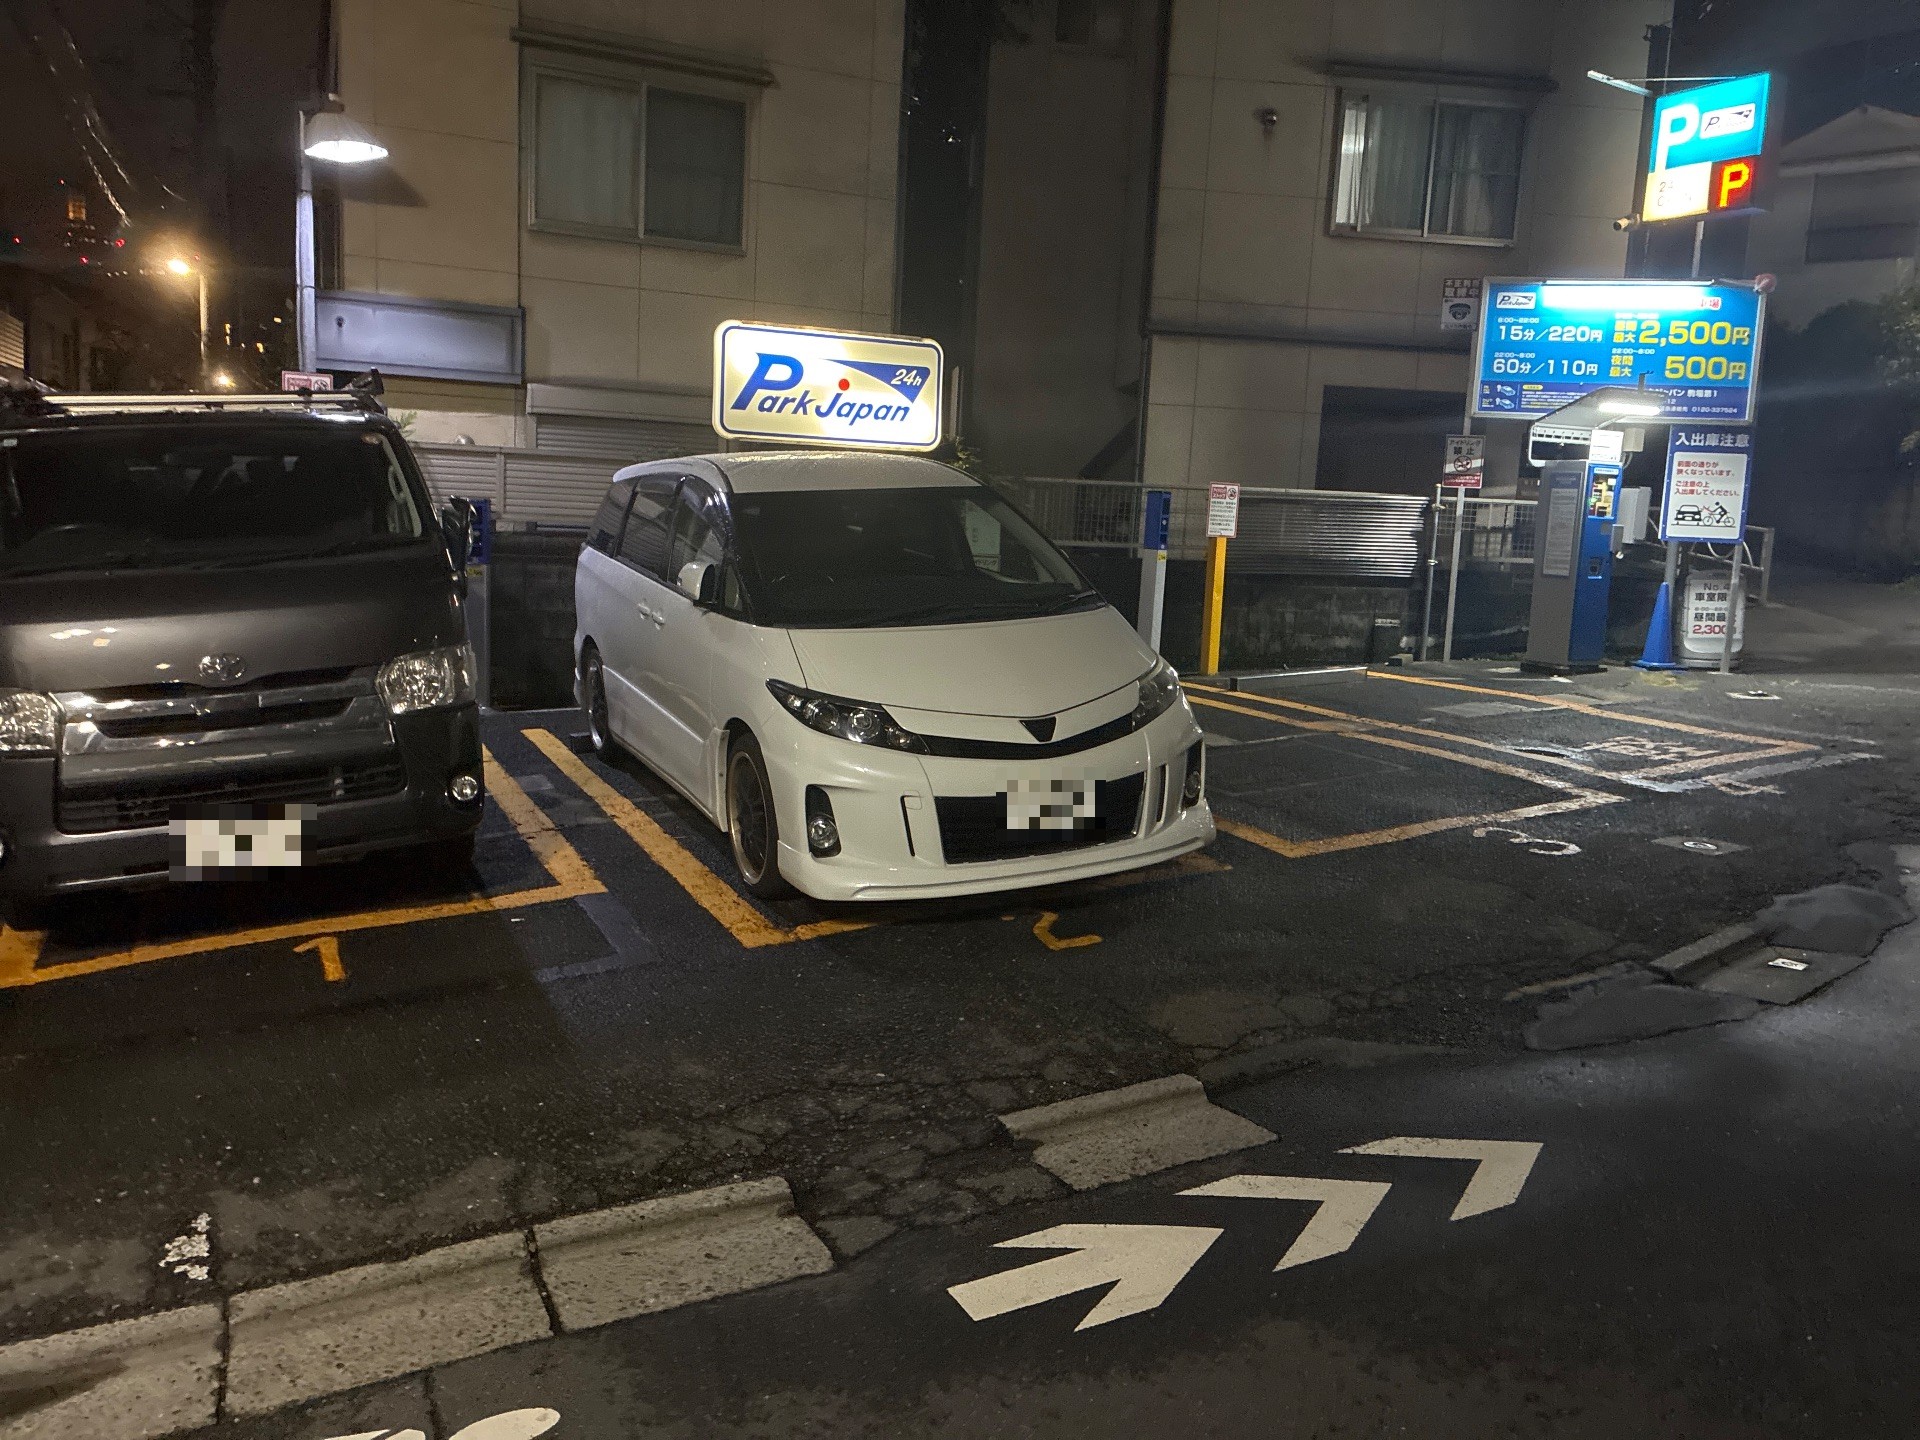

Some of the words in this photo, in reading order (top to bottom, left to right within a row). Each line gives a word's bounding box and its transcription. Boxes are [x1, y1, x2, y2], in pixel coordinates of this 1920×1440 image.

[1655, 103, 1699, 171] P
[1719, 163, 1749, 208] P
[1639, 320, 1751, 346] 2,500円
[890, 368, 923, 387] 24h
[1664, 356, 1747, 380] 500円
[731, 352, 816, 416] Park
[814, 385, 910, 426] Japan
[1675, 432, 1750, 448] 入出庫注意
[1694, 612, 1726, 622] 昼間最
[1472, 826, 1582, 856] 3
[292, 936, 347, 982] 1
